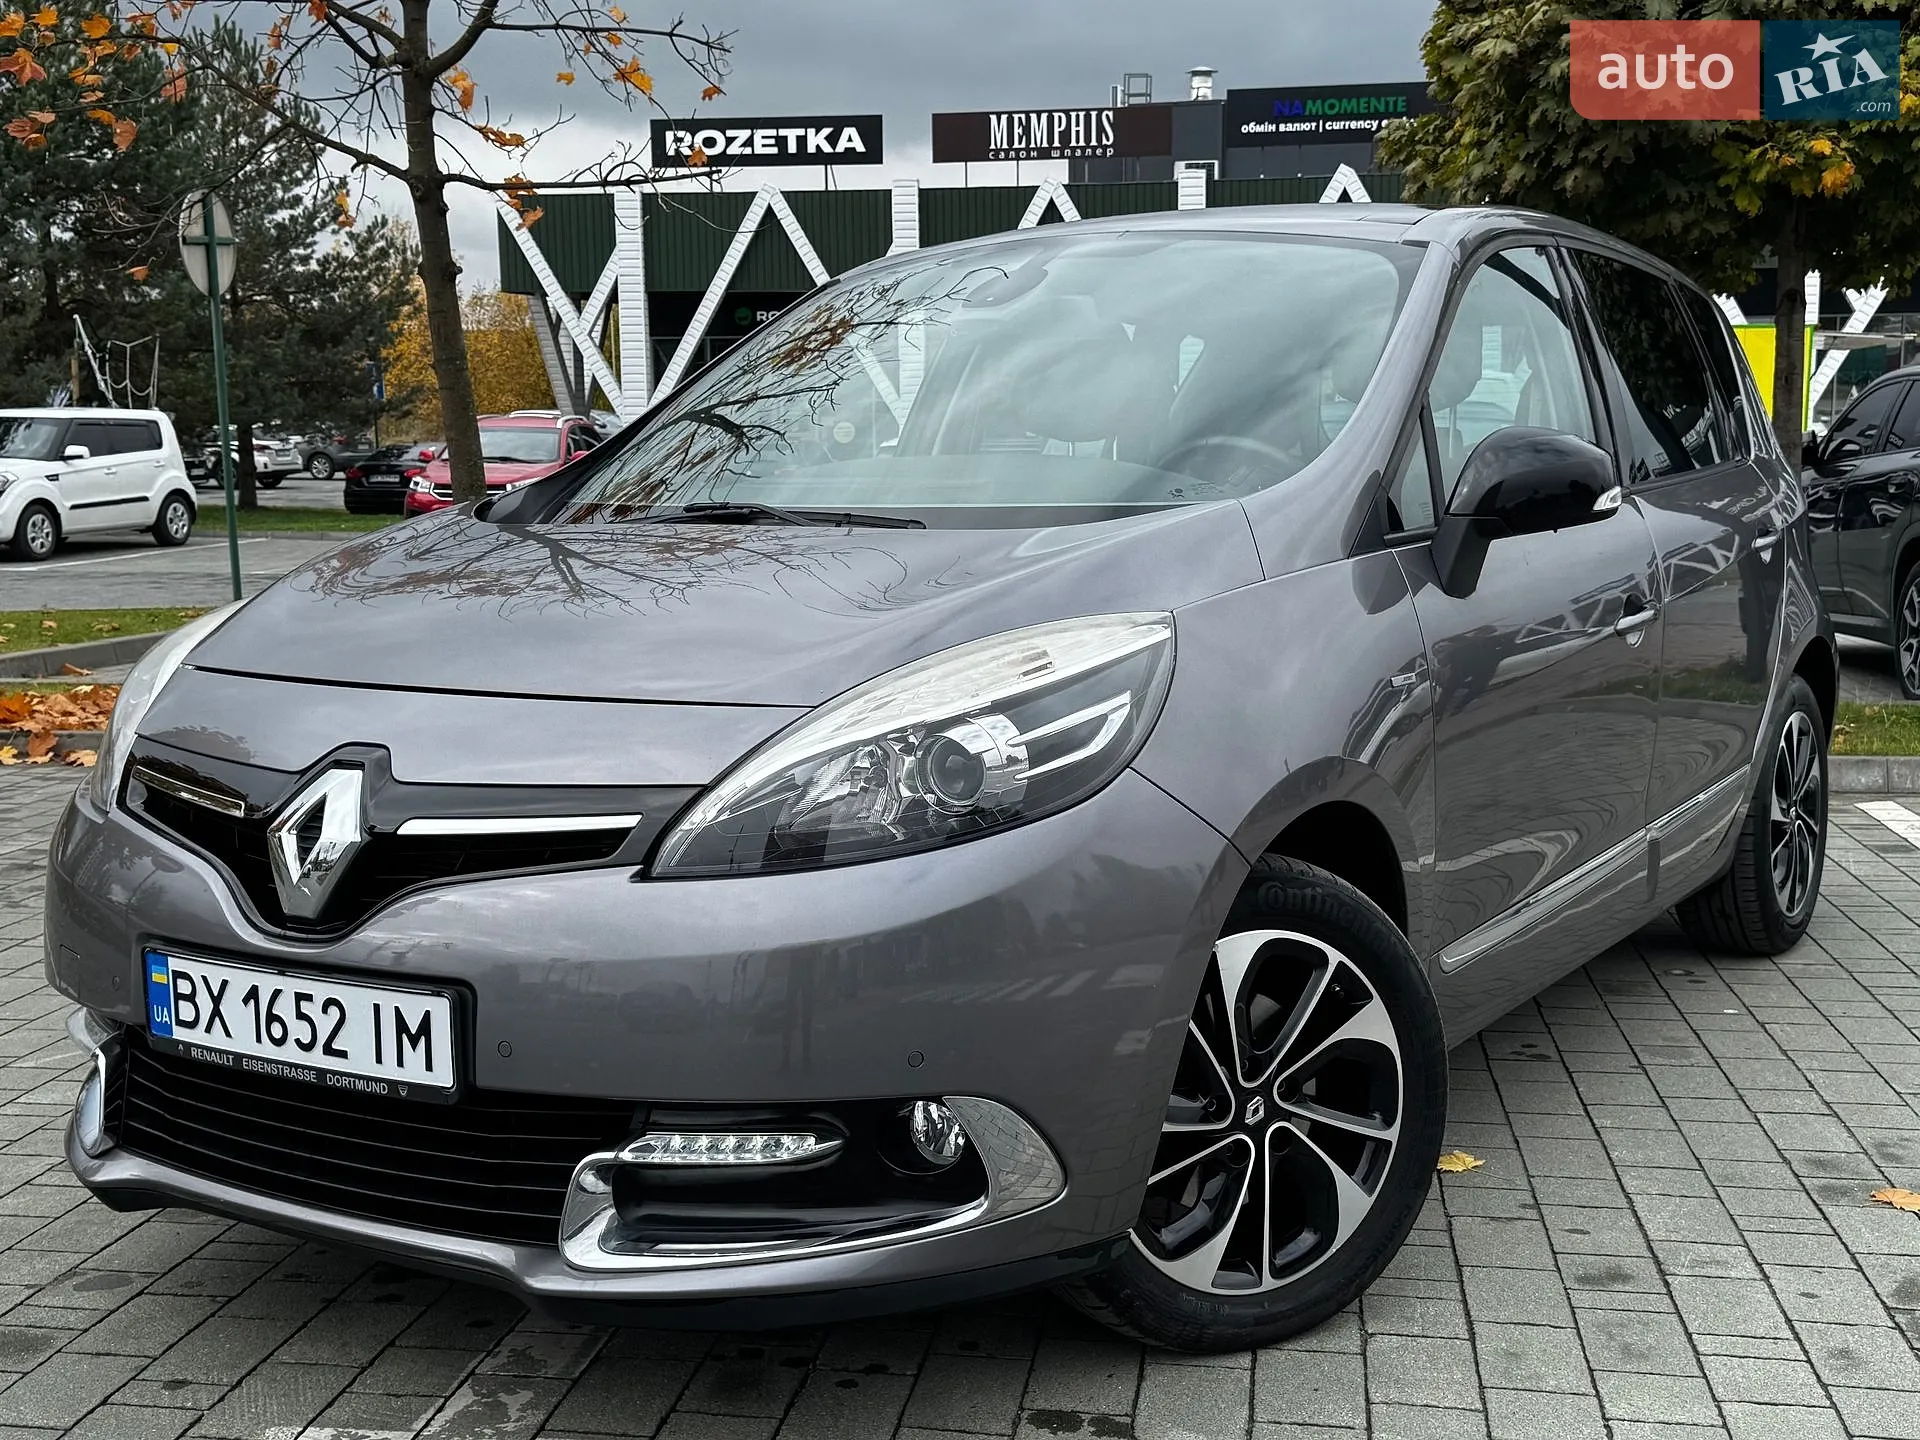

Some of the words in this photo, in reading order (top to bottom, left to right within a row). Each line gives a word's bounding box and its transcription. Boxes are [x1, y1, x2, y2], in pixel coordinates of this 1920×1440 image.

[1273, 96, 1407, 116] NAMOMENTE
[989, 110, 1115, 150] MEMPHIS
[1241, 121, 1276, 133] обмін
[1279, 120, 1316, 132] валют
[1325, 117, 1379, 131] currency
[665, 126, 867, 157] ROZETKA
[988, 150, 1038, 160] салон
[1050, 147, 1115, 158] шпалер
[153, 1004, 171, 1025] UA
[171, 969, 233, 1039] BX
[241, 984, 349, 1060] 1652
[373, 1003, 433, 1073] IM
[191, 1047, 234, 1066] RENAULT
[242, 1058, 317, 1082] EISENSTRASSE
[326, 1073, 389, 1095] DORTMUND
